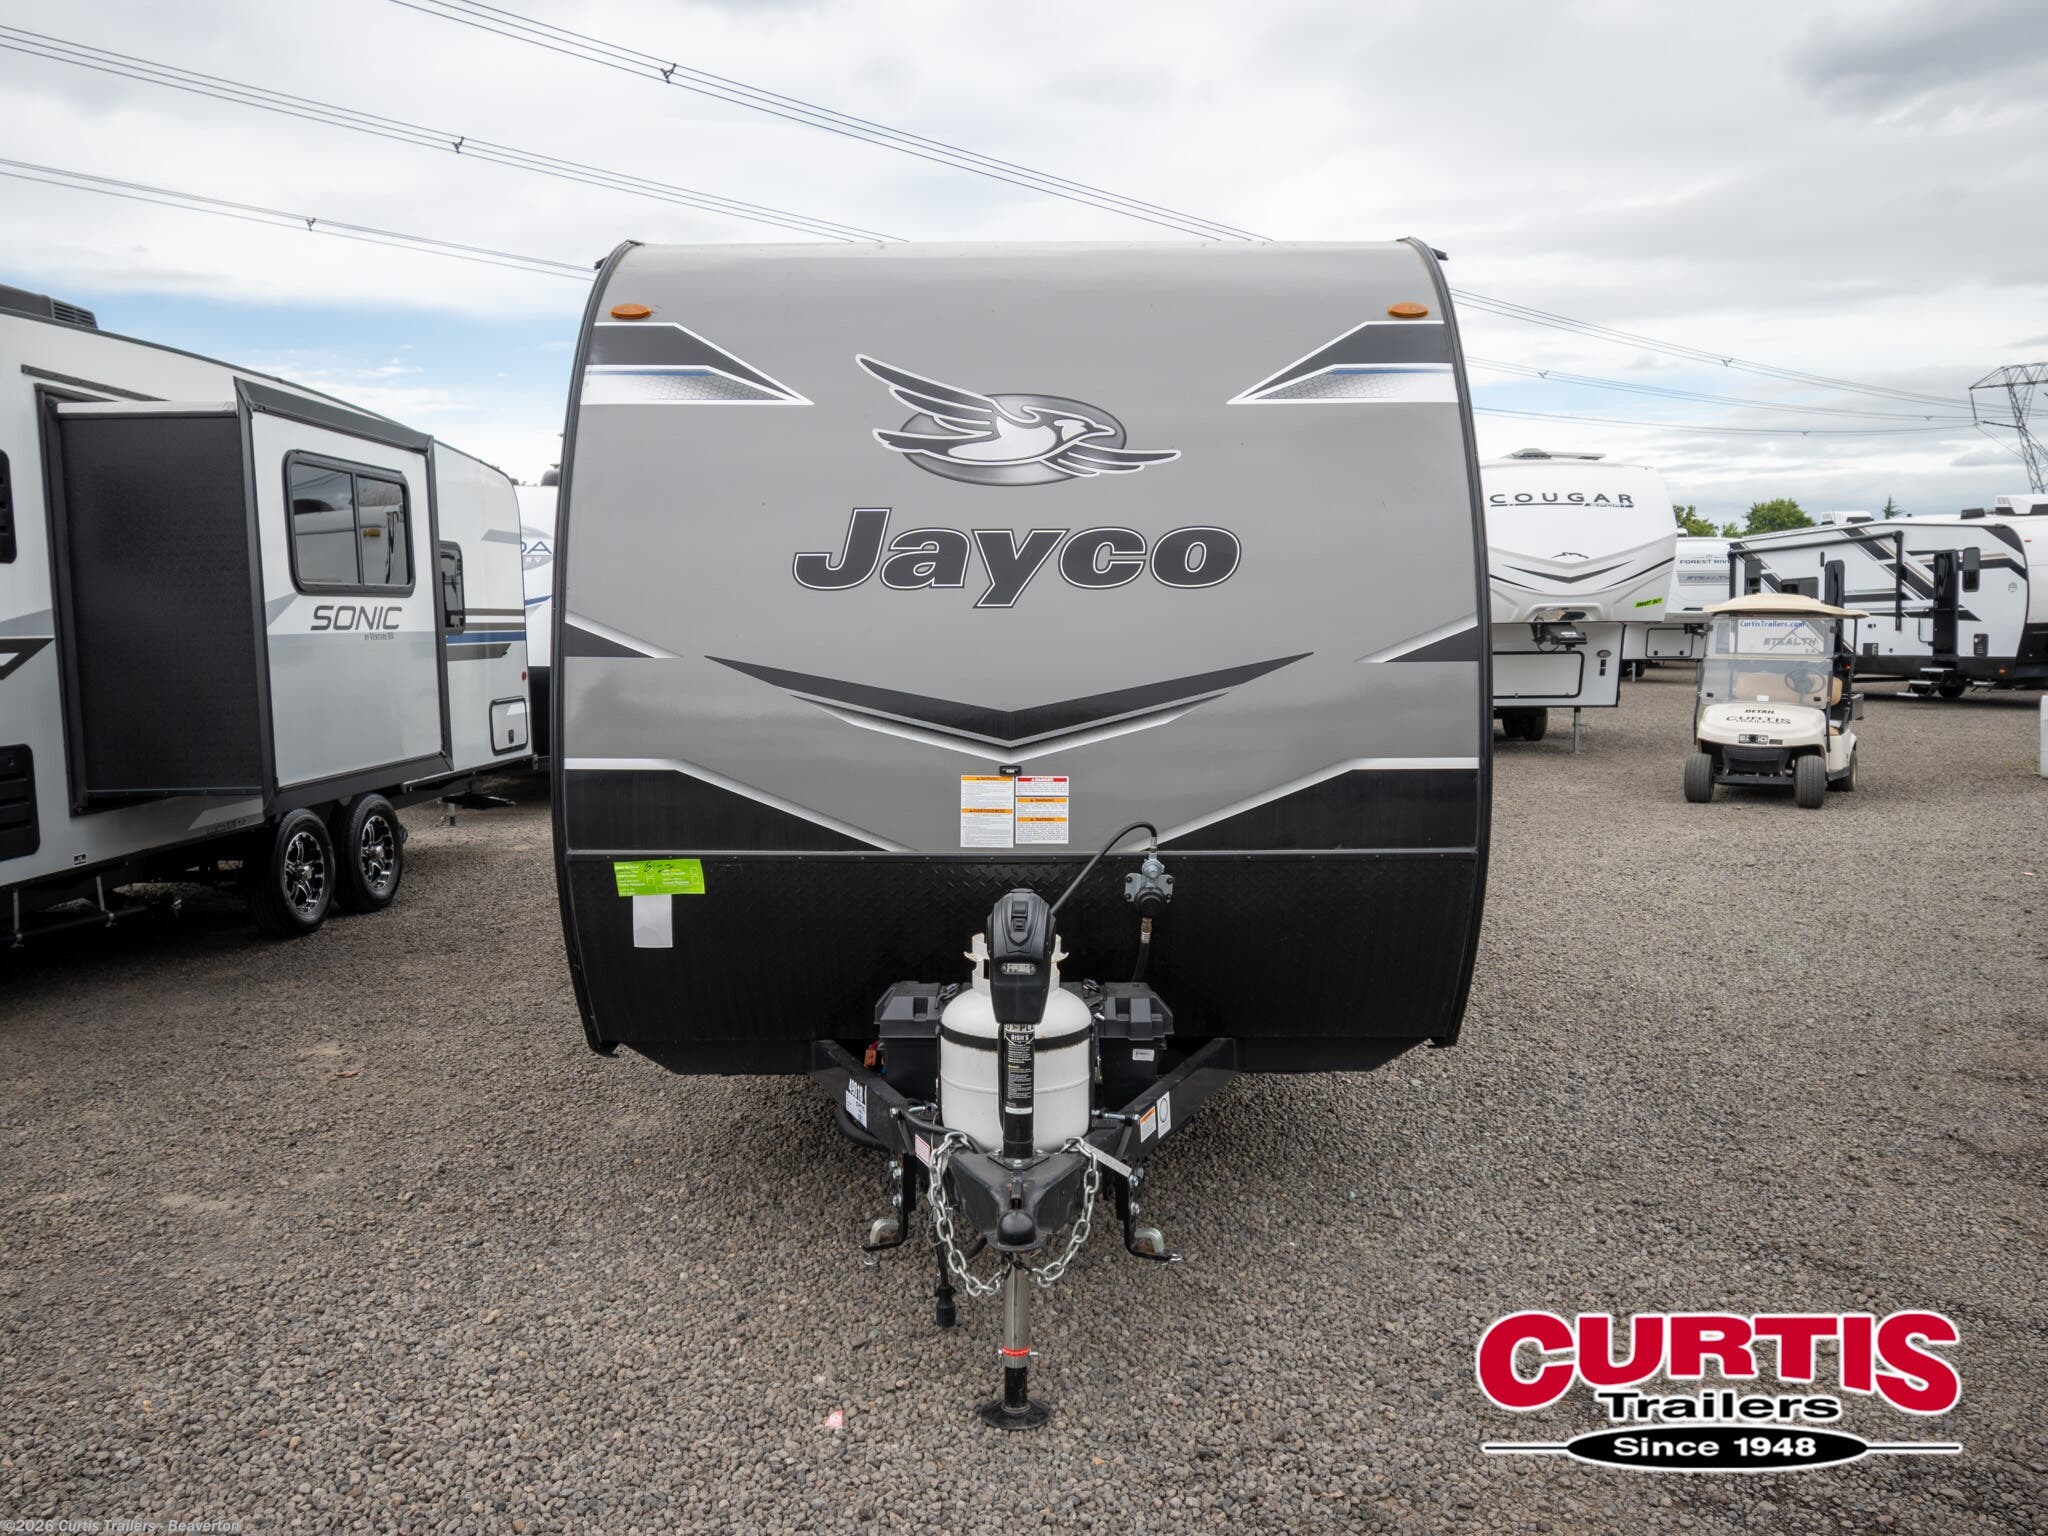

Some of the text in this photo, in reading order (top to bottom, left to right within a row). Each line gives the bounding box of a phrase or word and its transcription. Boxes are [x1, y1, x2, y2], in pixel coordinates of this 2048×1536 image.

[1489, 493, 1633, 504] COUGAR
[792, 507, 1241, 609] Jayco
[310, 605, 403, 631] SONIC
[1740, 620, 1806, 628] CurtisTrailers.com
